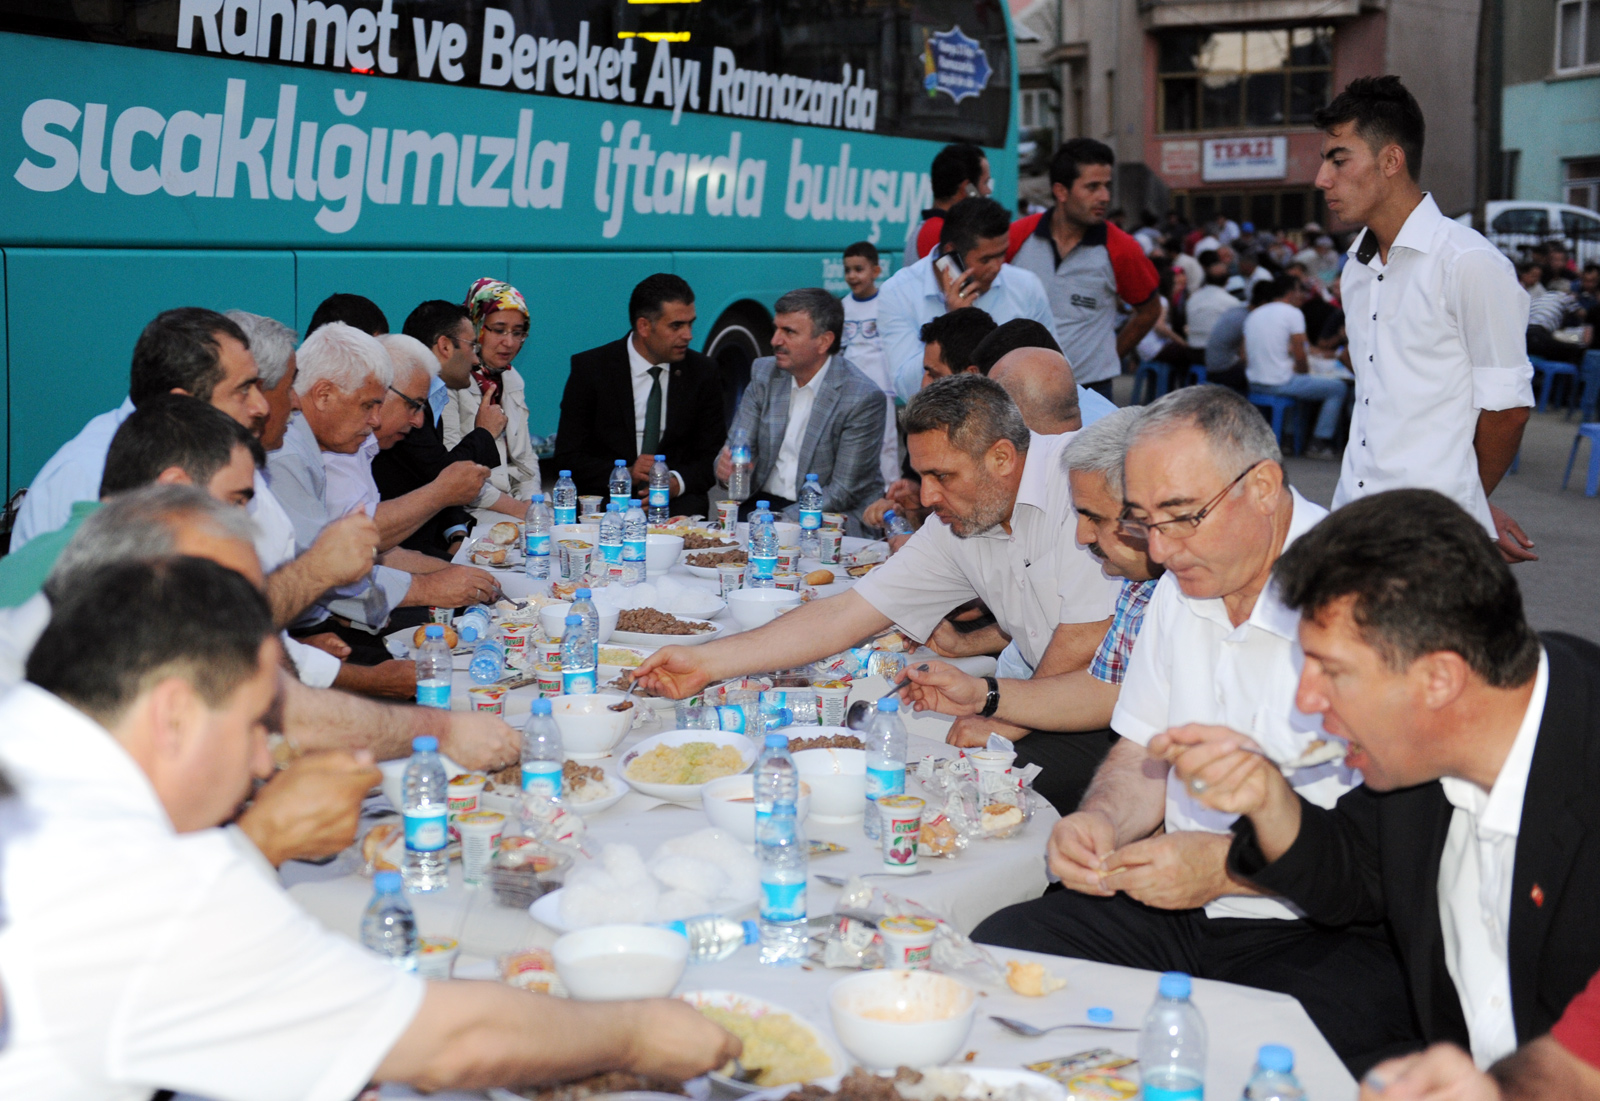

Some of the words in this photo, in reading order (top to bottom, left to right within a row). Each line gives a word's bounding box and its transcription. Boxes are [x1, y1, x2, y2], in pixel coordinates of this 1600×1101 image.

[177, 0, 398, 74] Rahmet
[412, 17, 467, 82] ve
[480, 7, 637, 102] Bereket
[643, 38, 700, 126] Ayı
[709, 46, 878, 131] Ramazan'da
[13, 78, 570, 234] sıcaklığımızla
[594, 119, 767, 239] iftarda
[784, 138, 934, 246] buluşuy
